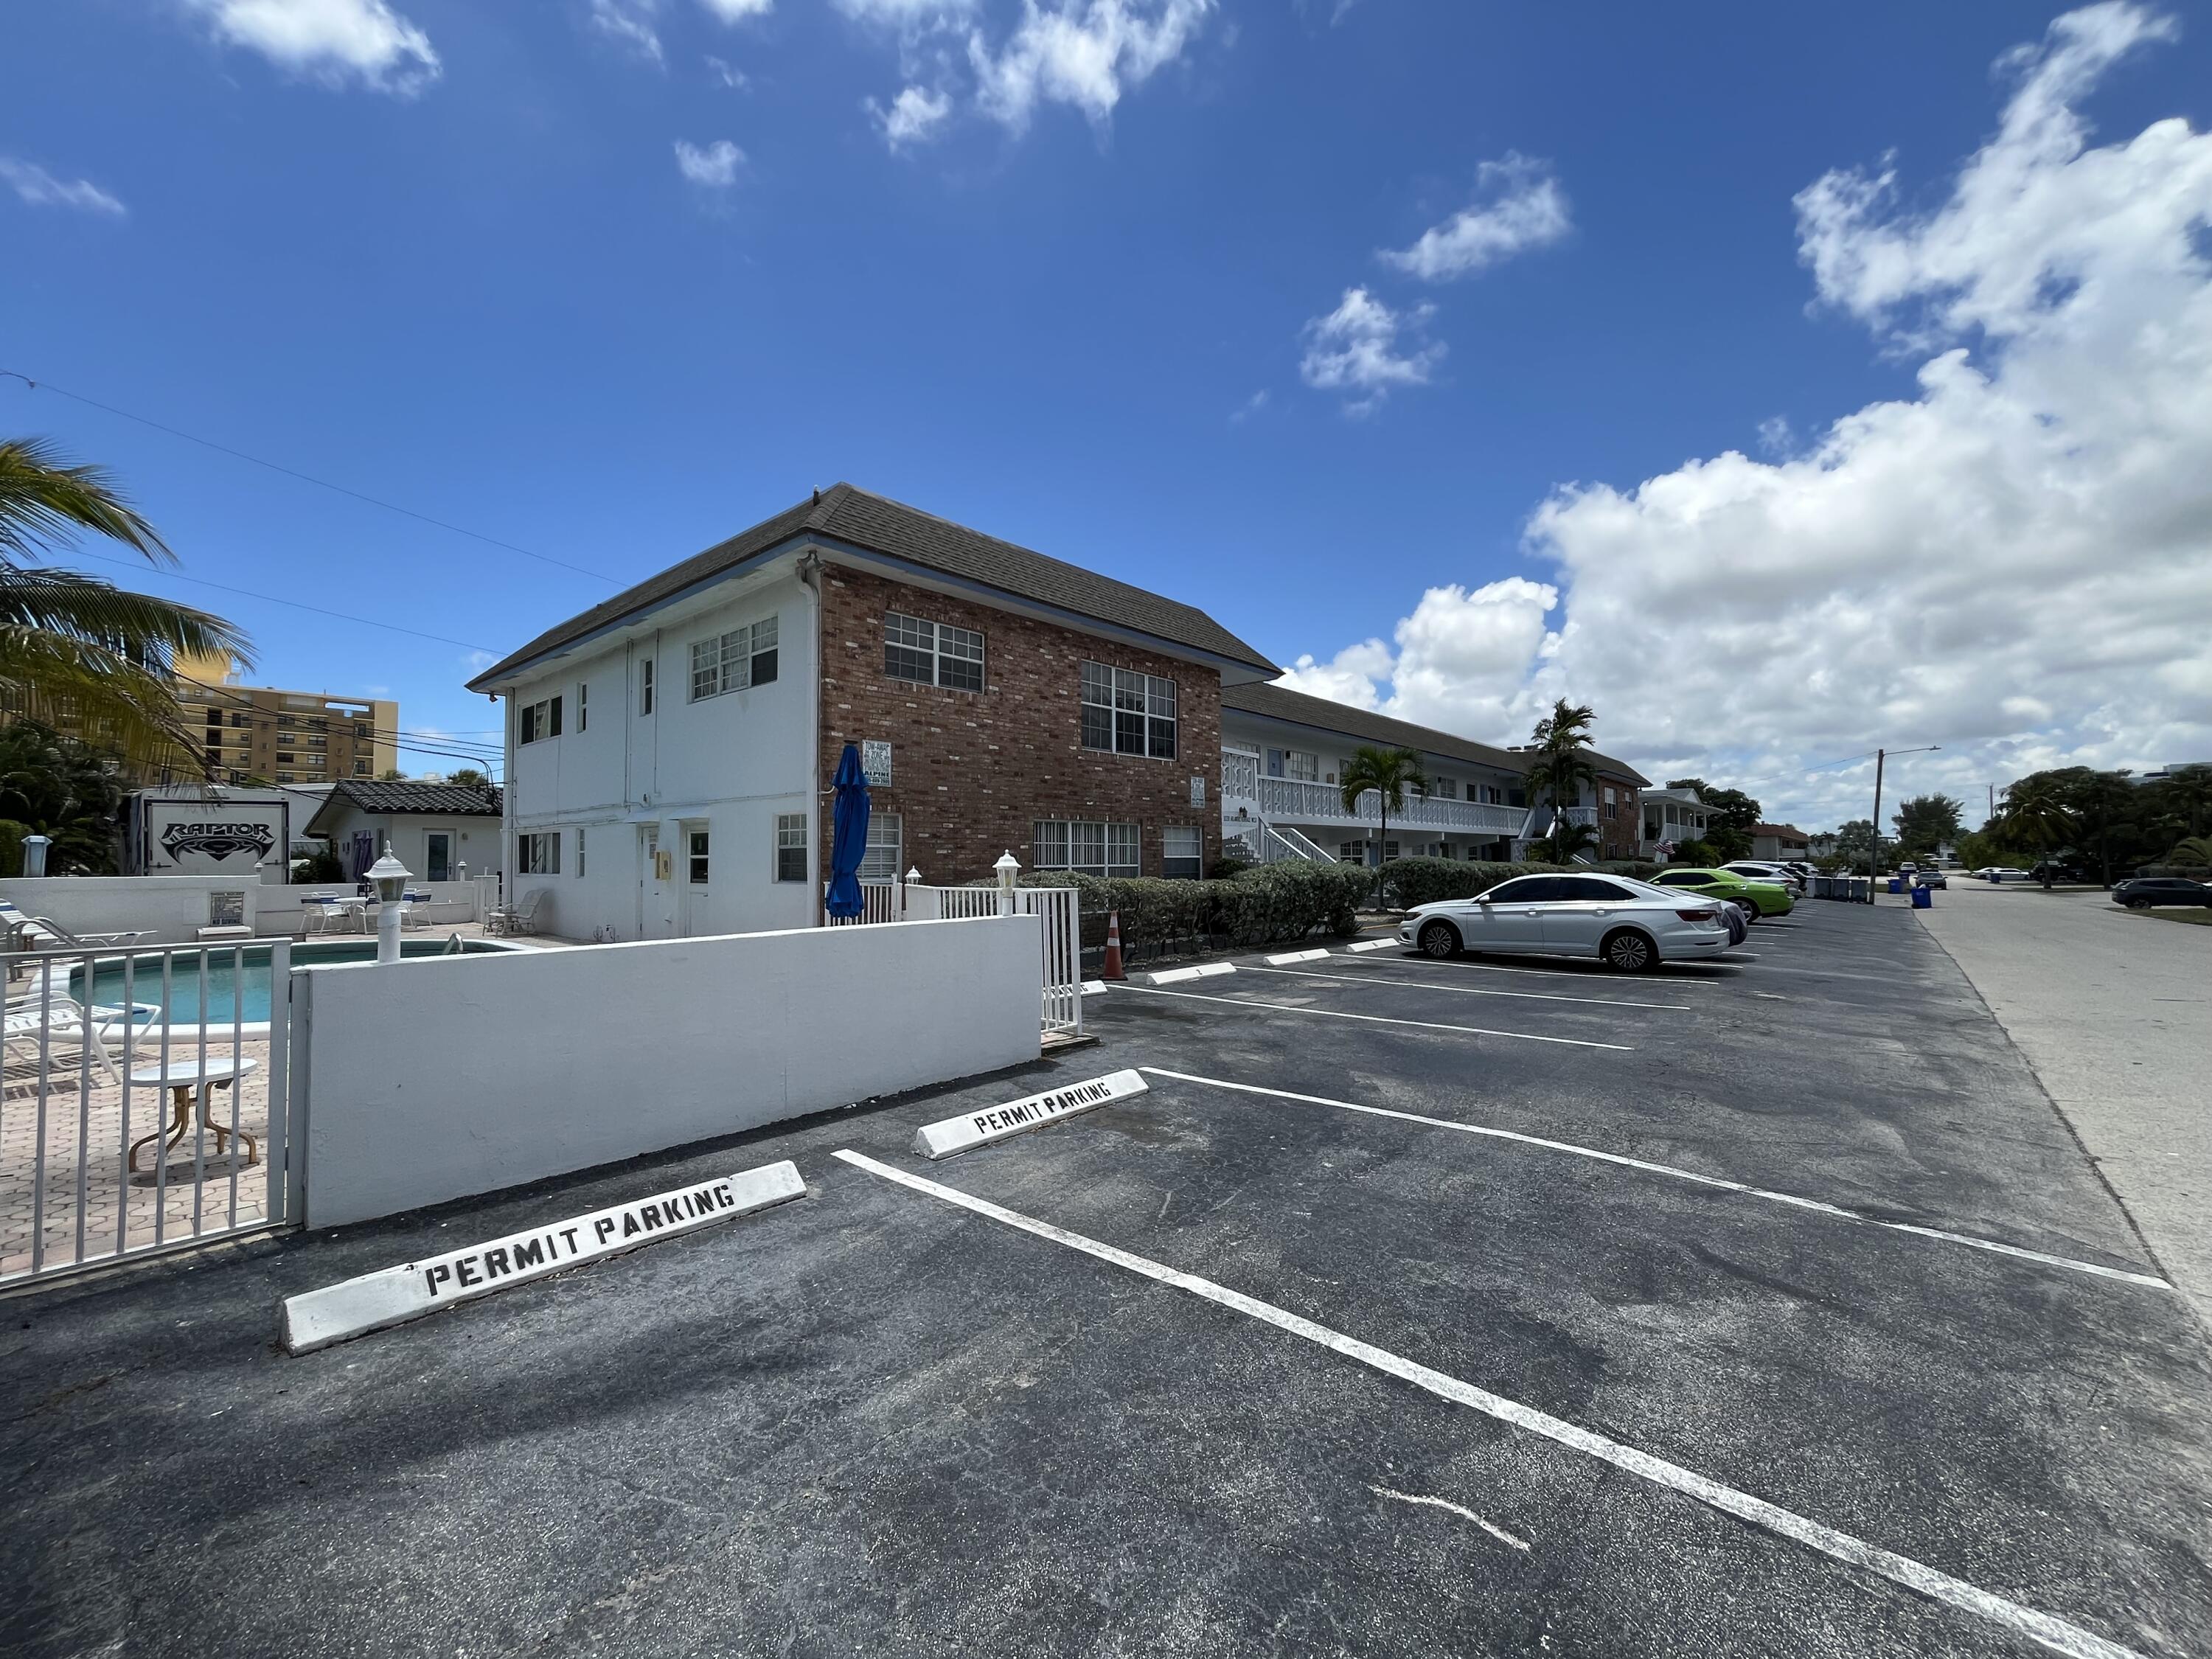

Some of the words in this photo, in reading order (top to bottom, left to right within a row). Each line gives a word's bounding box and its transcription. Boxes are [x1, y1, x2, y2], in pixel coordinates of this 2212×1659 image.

[865, 741, 889, 751] TOW-AWAY
[871, 751, 883, 759] ZONE
[161, 823, 274, 840] RAPTOR
[973, 1102, 1043, 1134] PERMIT
[1043, 1082, 1111, 1113] PARKING
[425, 1227, 578, 1297] PERMIT
[594, 1184, 734, 1245] PARKING
